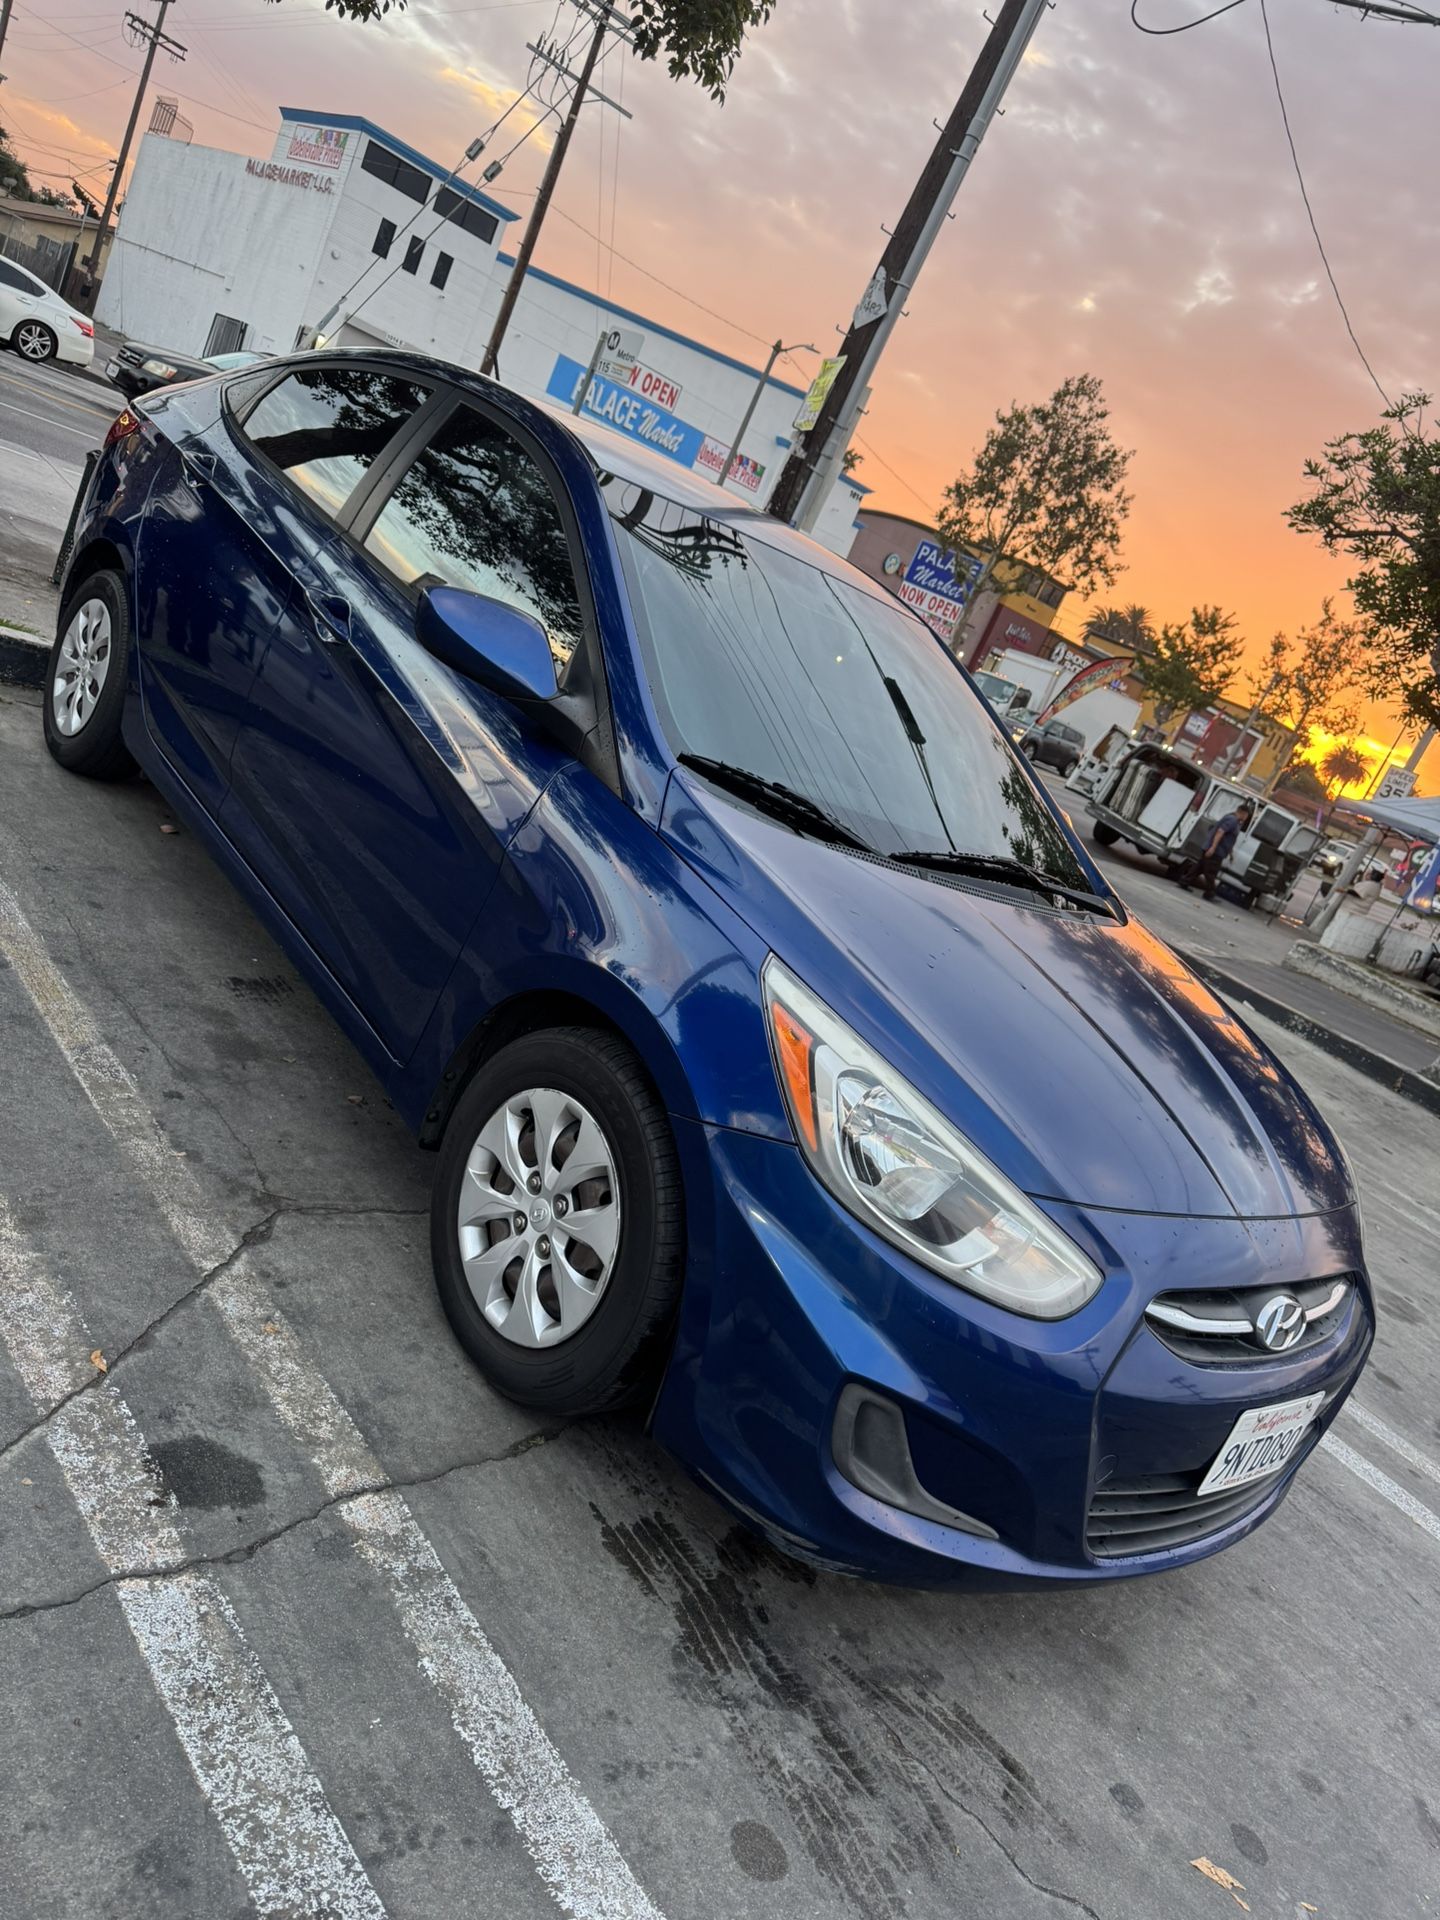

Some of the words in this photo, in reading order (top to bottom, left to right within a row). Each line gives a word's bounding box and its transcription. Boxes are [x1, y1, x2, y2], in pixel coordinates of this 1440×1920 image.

[598, 360, 611, 374] 115
[616, 349, 636, 362] Metro
[641, 372, 678, 409] OPEN
[638, 408, 685, 453] Market
[917, 544, 980, 576] PALAE
[913, 565, 964, 598] Market
[899, 584, 927, 606] NOW
[927, 596, 960, 621] OPEN
[1387, 776, 1409, 789] LIMIT
[1389, 768, 1415, 783] SPEED
[1252, 1408, 1303, 1434] California
[1210, 1425, 1304, 1483] 9NTD080
